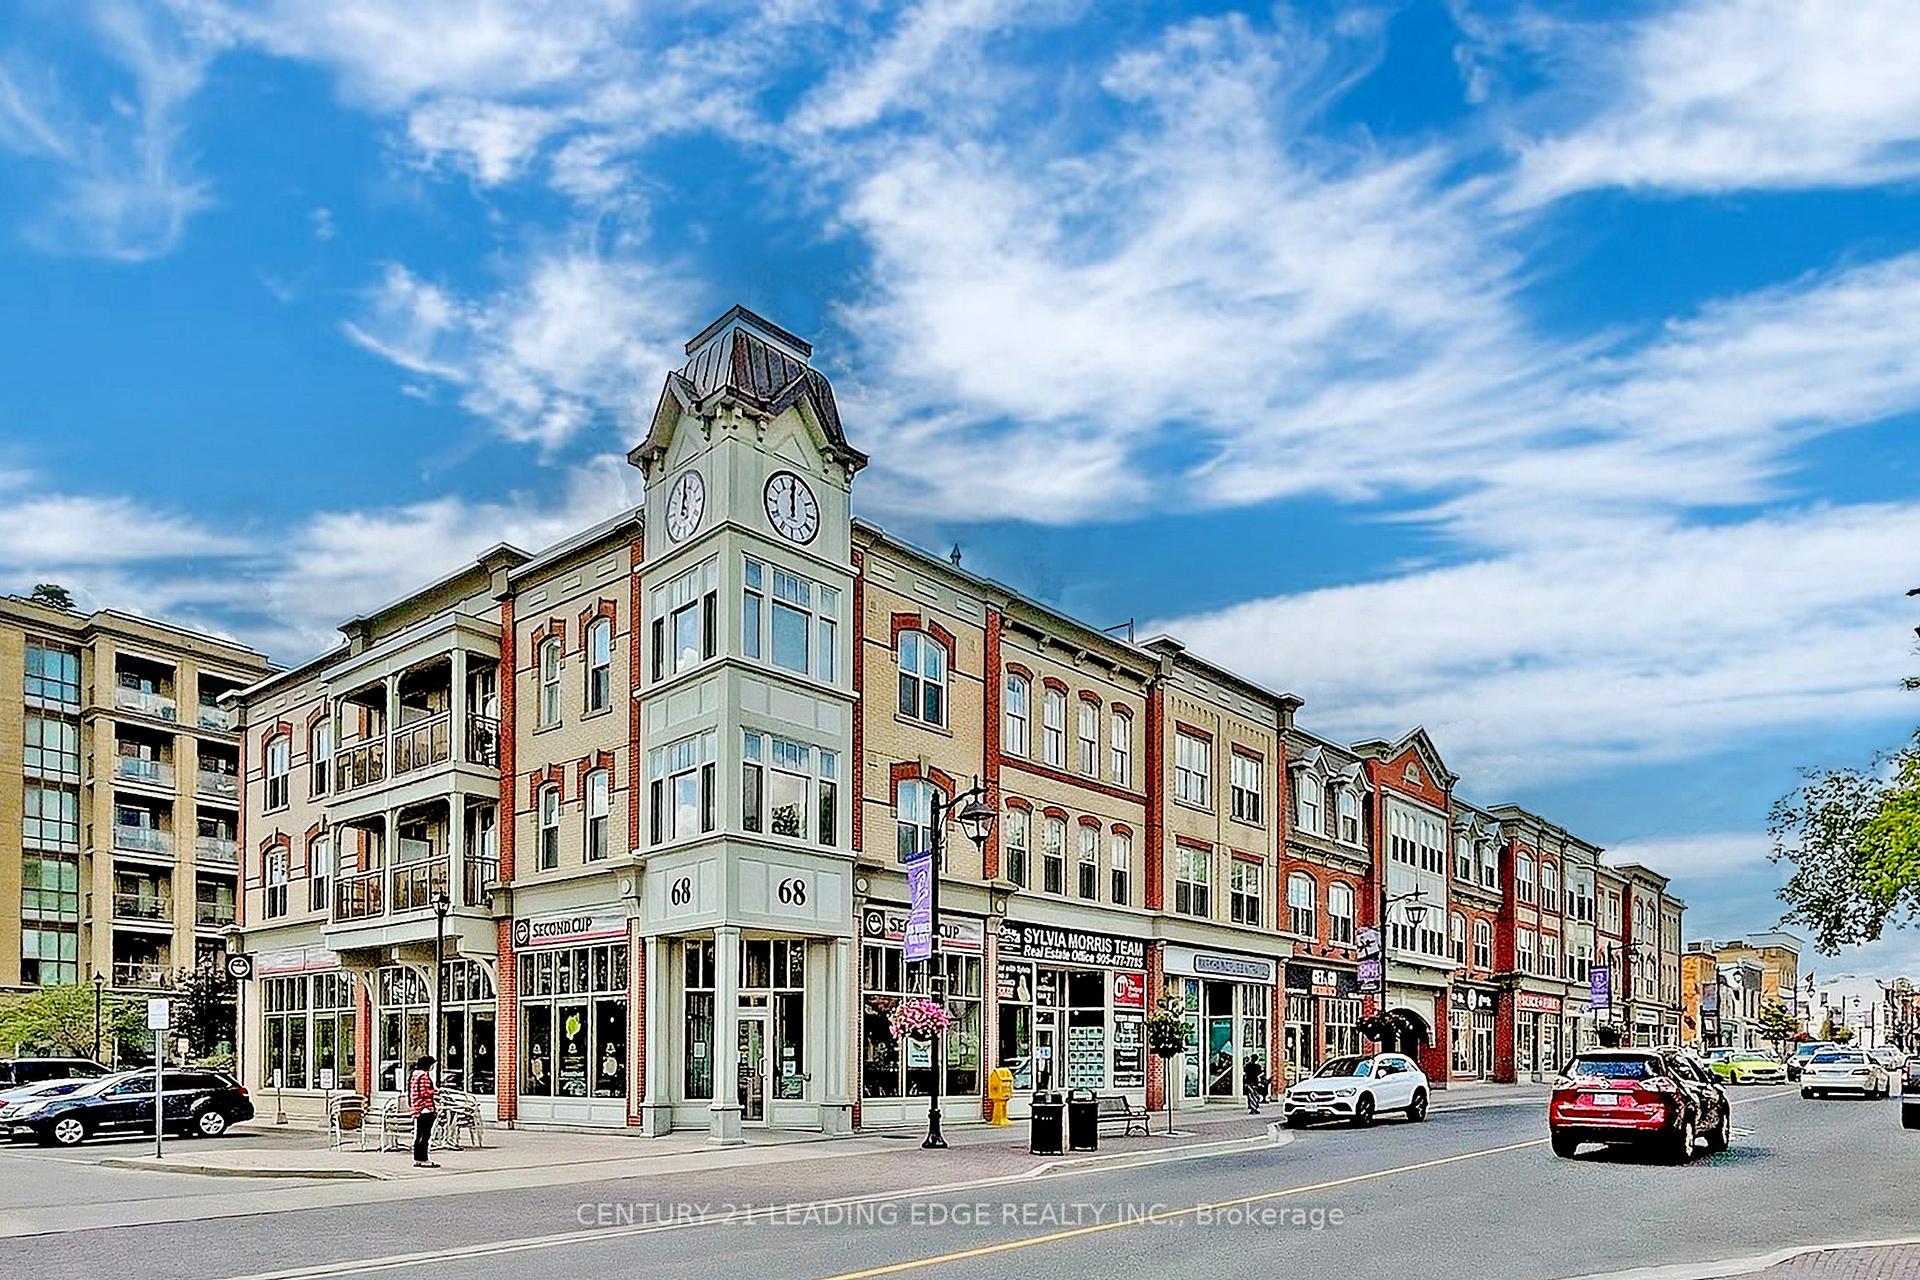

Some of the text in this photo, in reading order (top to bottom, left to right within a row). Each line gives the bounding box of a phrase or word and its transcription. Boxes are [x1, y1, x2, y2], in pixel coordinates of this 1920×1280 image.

[671, 877, 691, 906] 68
[778, 877, 806, 906] 68
[573, 917, 593, 932] CUP
[1024, 927, 1067, 948] SYLVIA
[1068, 933, 1112, 953] MORRIS
[1113, 939, 1144, 957] TEAM
[1024, 945, 1044, 958] Real
[1044, 946, 1071, 960] Estate
[1071, 949, 1095, 963] Office
